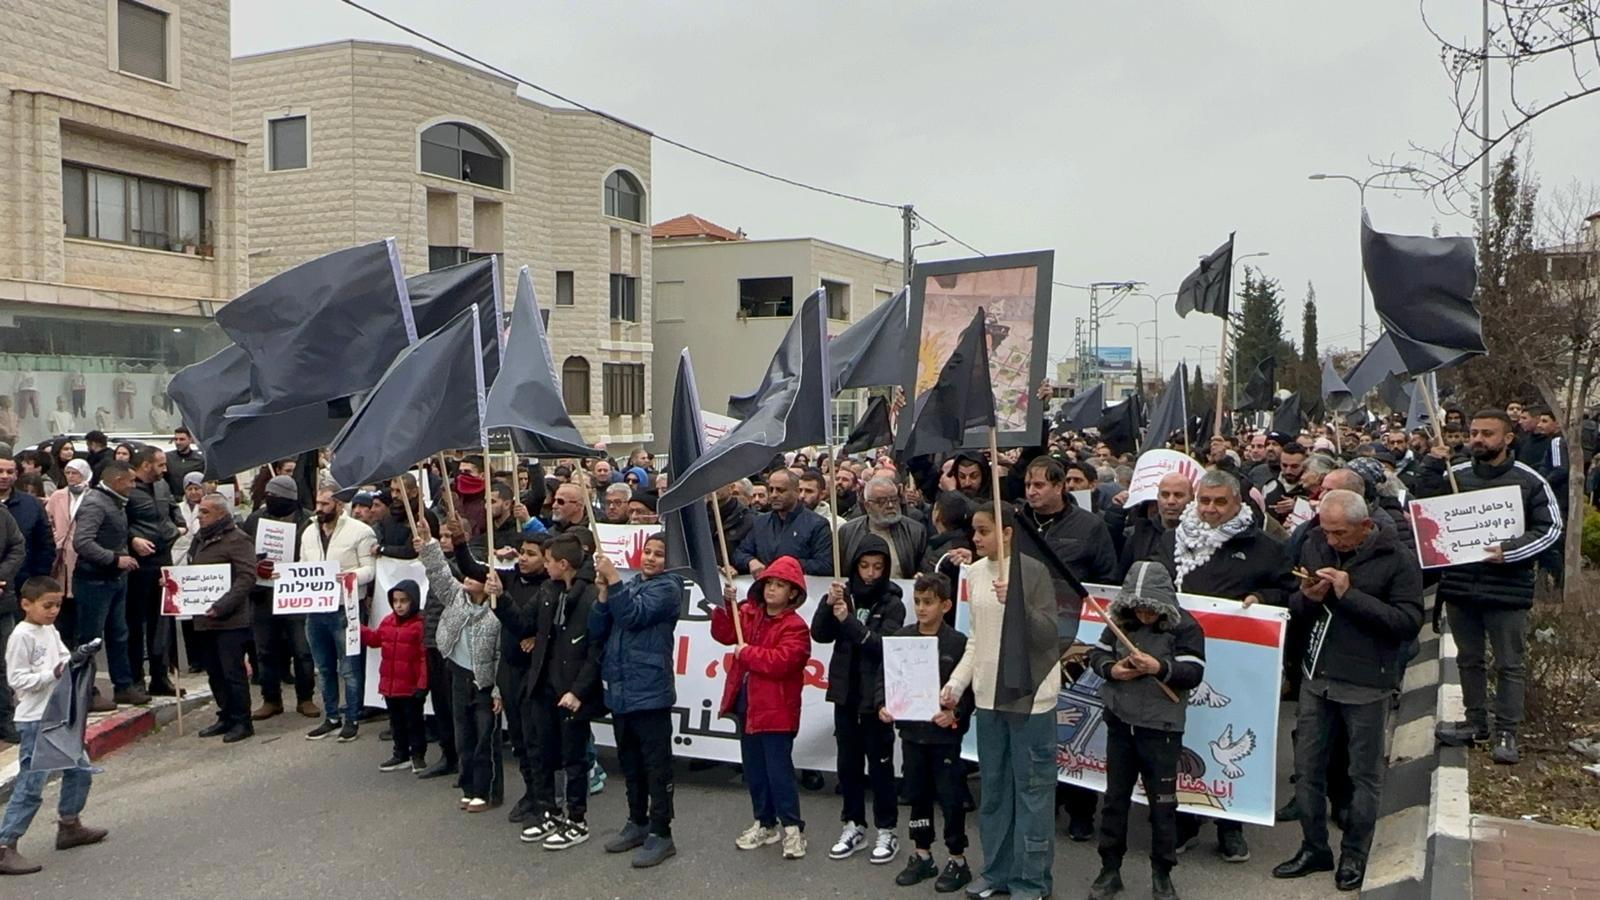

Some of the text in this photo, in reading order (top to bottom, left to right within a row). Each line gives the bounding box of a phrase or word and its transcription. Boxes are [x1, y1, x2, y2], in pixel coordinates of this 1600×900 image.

[1444, 501, 1514, 521] يا حامل السلاح
[1503, 517, 1516, 529] دم
[288, 566, 325, 578] חוסר
[278, 581, 335, 593] משילות
[277, 596, 334, 609] זה פשע
